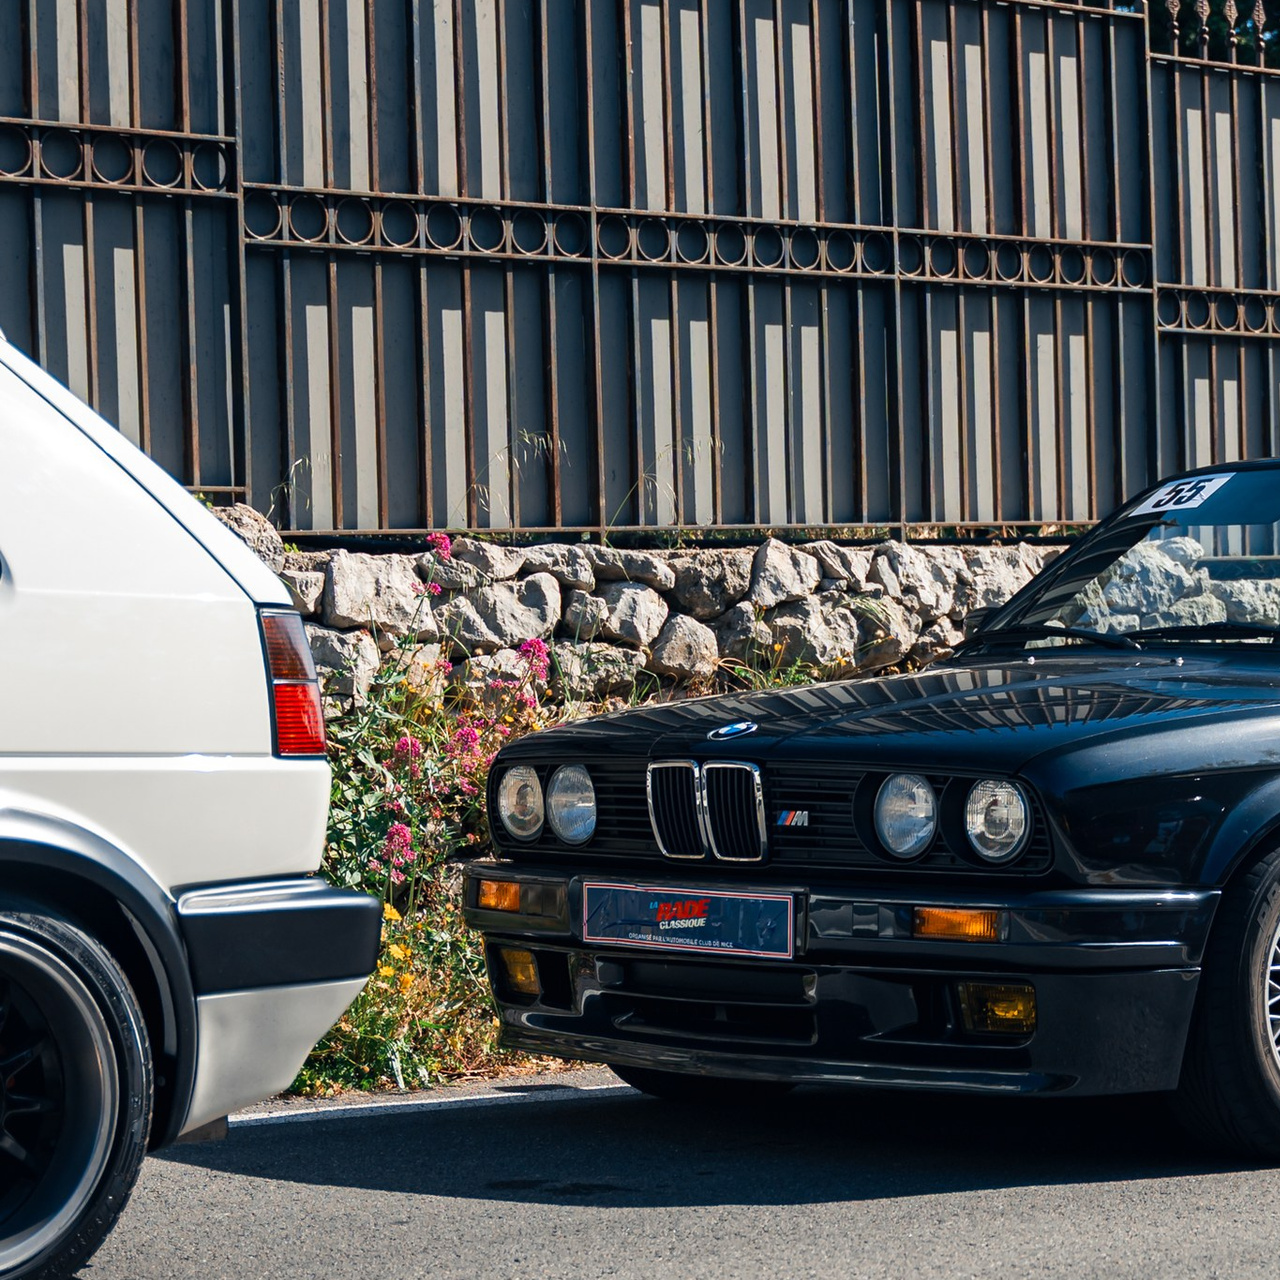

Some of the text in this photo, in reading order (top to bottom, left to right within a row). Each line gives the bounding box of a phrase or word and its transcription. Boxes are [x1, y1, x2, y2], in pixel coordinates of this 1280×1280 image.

[1151, 478, 1216, 509] 55
[649, 898, 711, 922] LA RADE
[659, 917, 707, 930] CLASSIQUE
[698, 939, 712, 947] CLUB
